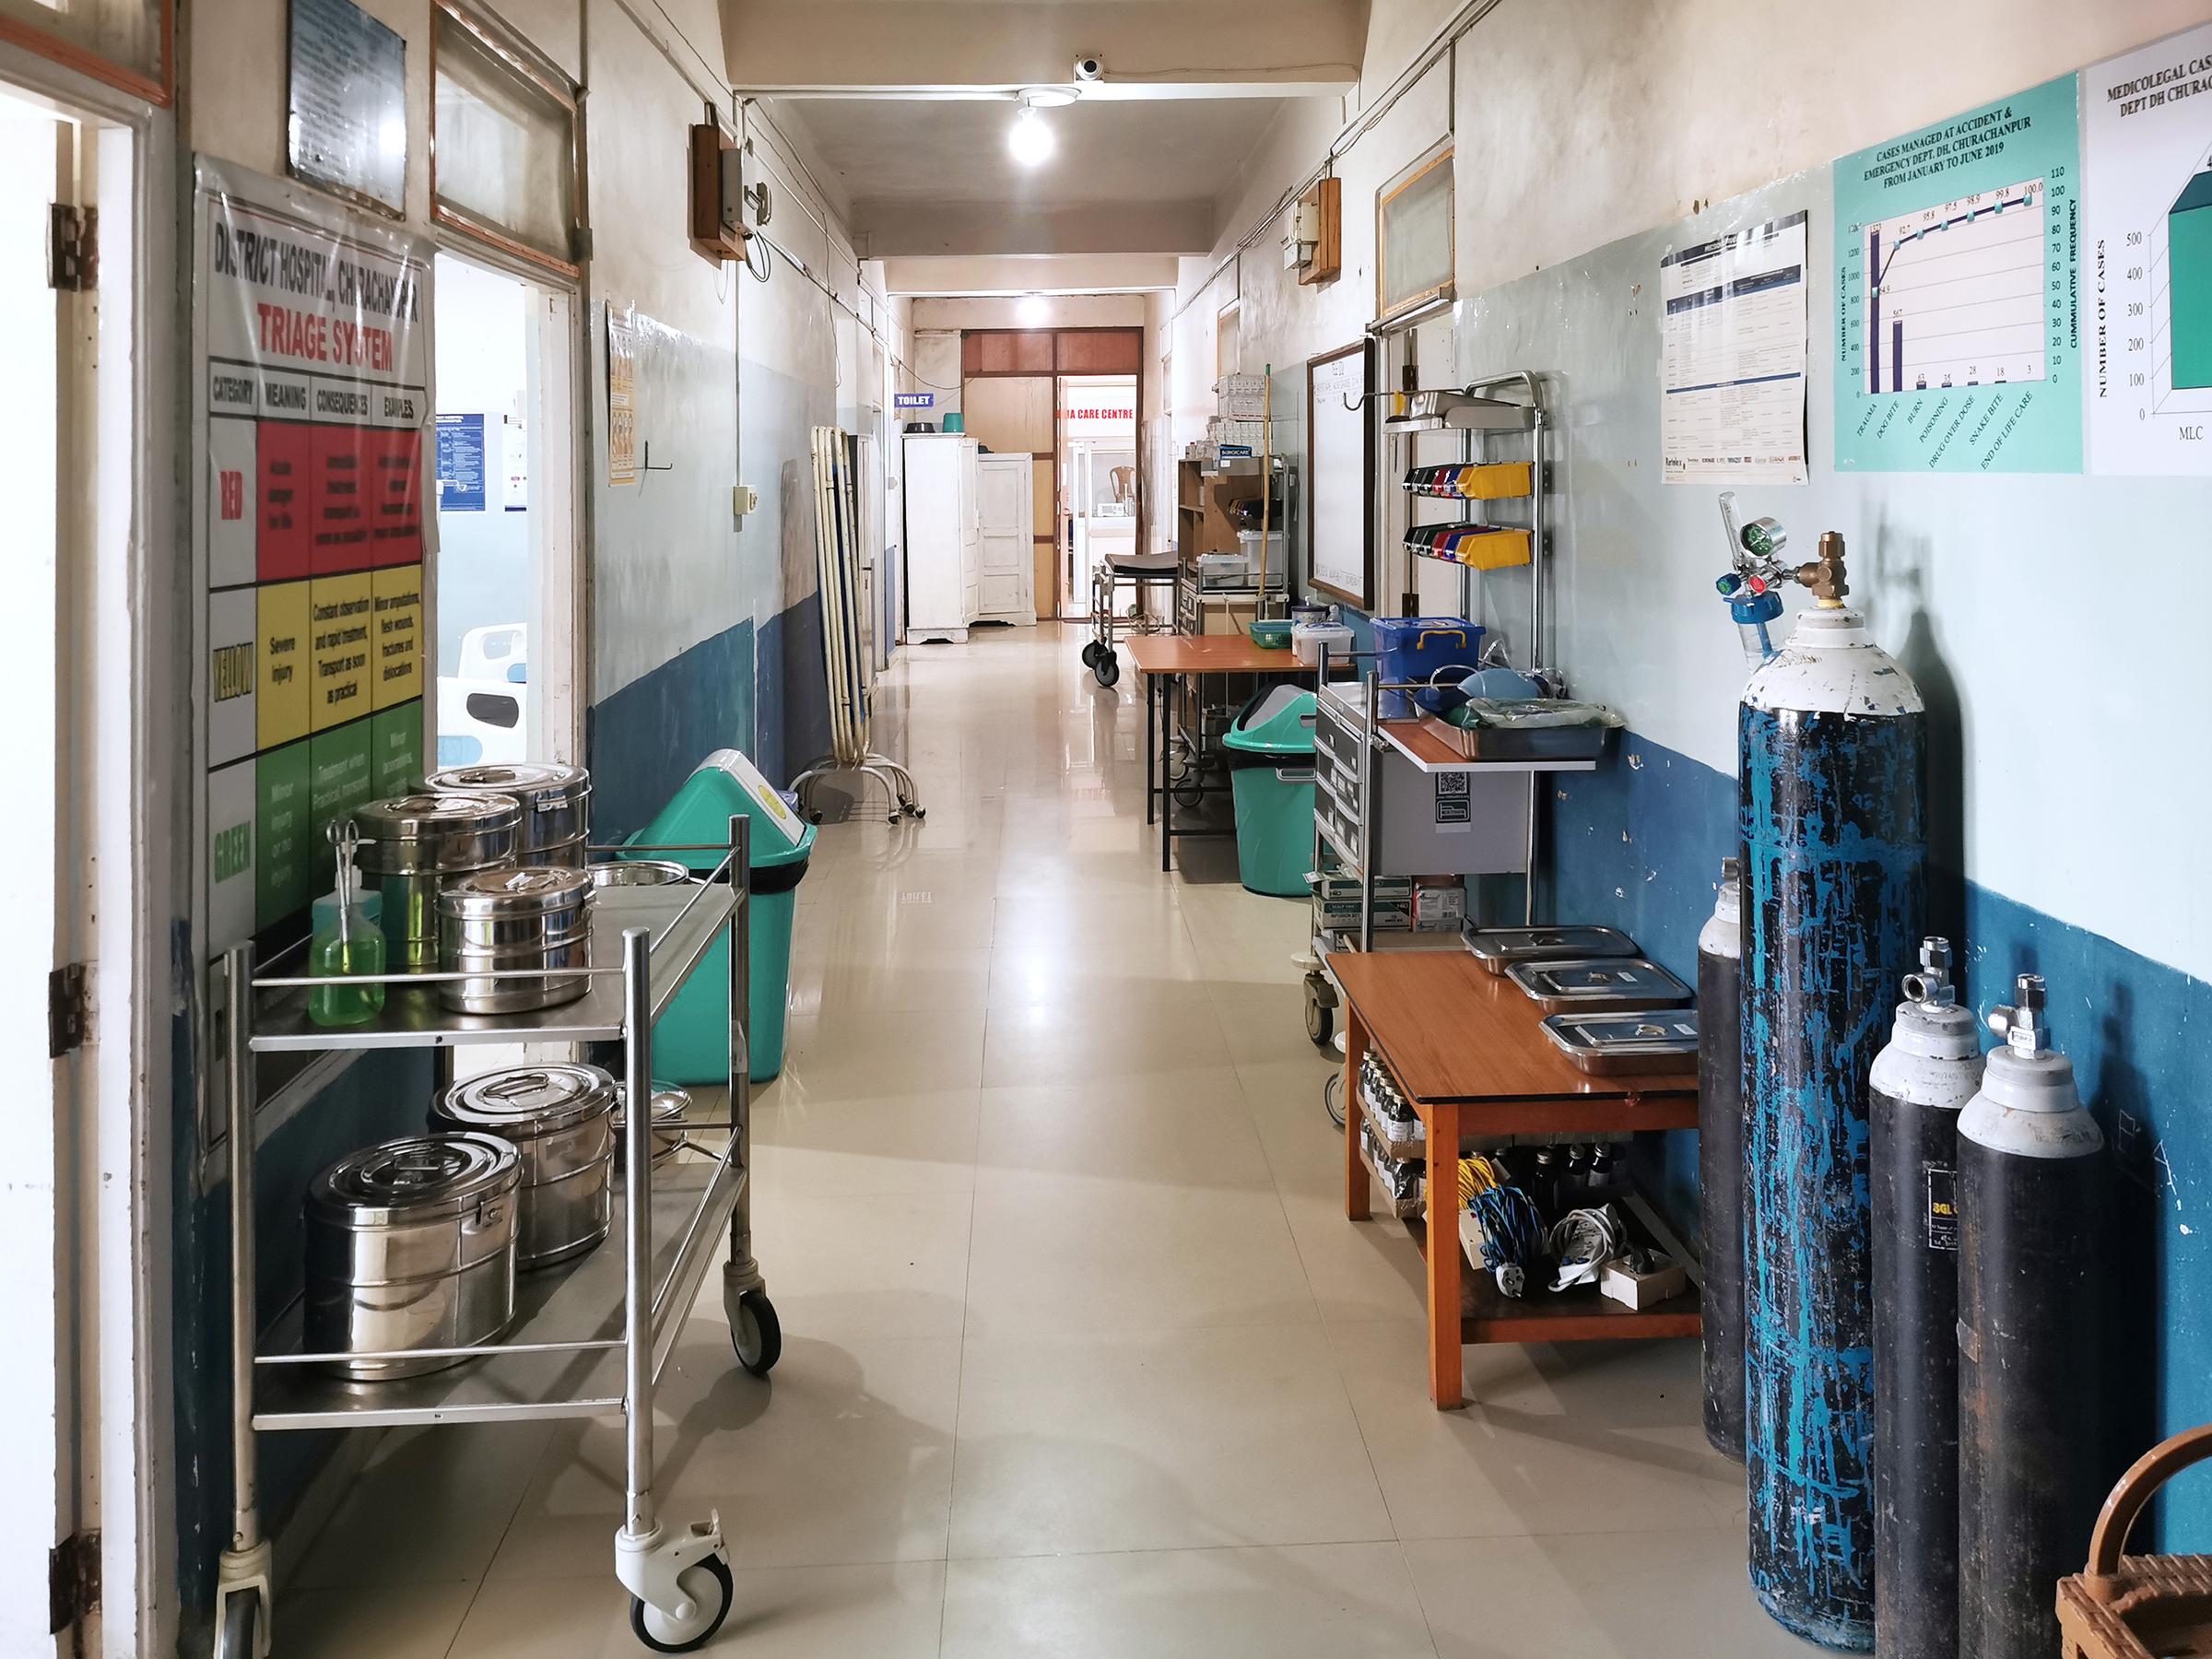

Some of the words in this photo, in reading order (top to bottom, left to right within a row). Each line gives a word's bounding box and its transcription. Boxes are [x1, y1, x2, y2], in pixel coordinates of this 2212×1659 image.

[2107, 65, 2186, 102] MEDICOLEGAL
[2120, 97, 2147, 117] DEPT
[2149, 90, 2165, 109] DH
[1877, 145, 1900, 162] CASES
[1901, 132, 1942, 153] MANAGED
[1943, 126, 1955, 139] AT
[1956, 110, 2003, 135] ACCIDENT
[2004, 106, 2013, 119] &
[1865, 156, 1912, 181] EMERGENCY
[1912, 148, 1936, 166] DEPT.
[1952, 116, 2031, 152] CHURACHANPUR
[1883, 172, 1906, 189] FROM
[1907, 161, 1946, 182] JANUARY
[1947, 156, 1959, 169] TO
[1959, 147, 1983, 165] JUNE
[1985, 141, 2005, 158] 2019
[2051, 166, 2065, 179] 110
[2052, 185, 2065, 197] 100
[2052, 206, 2061, 216] 90
[2052, 224, 2061, 235] 80
[2126, 231, 2143, 247] 500
[2052, 243, 2062, 253] 70
[2052, 262, 2061, 272] 60
[2097, 240, 2106, 293] CASES
[2126, 266, 2143, 280] 400
[2052, 280, 2061, 290] 50
[2052, 299, 2062, 309] 40
[2098, 297, 2107, 321] OF
[2127, 302, 2144, 317] 300
[2052, 318, 2062, 328] 30
[257, 302, 327, 362] TRIAGE
[2052, 336, 2062, 347] 20
[2128, 337, 2144, 352] 200
[2053, 355, 2062, 365] 10
[2098, 324, 2108, 398] NUMBER
[2052, 374, 2058, 383] 0
[2128, 372, 2145, 387] 100
[897, 395, 930, 406] TOILET
[1077, 409, 1100, 419] CARE
[1101, 409, 1134, 419] CENTRE
[1907, 398, 1924, 425] BURN
[2138, 408, 2145, 421] 0
[1856, 402, 1877, 438] TRAUMA
[1919, 396, 1949, 444] POISONING
[1969, 414, 1990, 446] SNAKE
[1987, 393, 2005, 416] BITE
[1876, 418, 1891, 441] DOG
[1929, 443, 1947, 469] DRUG
[1944, 420, 1960, 444] OVER
[1959, 394, 1976, 420] DOSE
[1981, 450, 1995, 471] END
[1993, 436, 2005, 452] OF
[2002, 418, 2018, 440] LIFE
[2014, 391, 2034, 418] CARE
[2179, 426, 2204, 441] MLC
[220, 471, 242, 520] RED
[212, 641, 253, 703] YELLOW
[214, 820, 252, 885] GREEN
